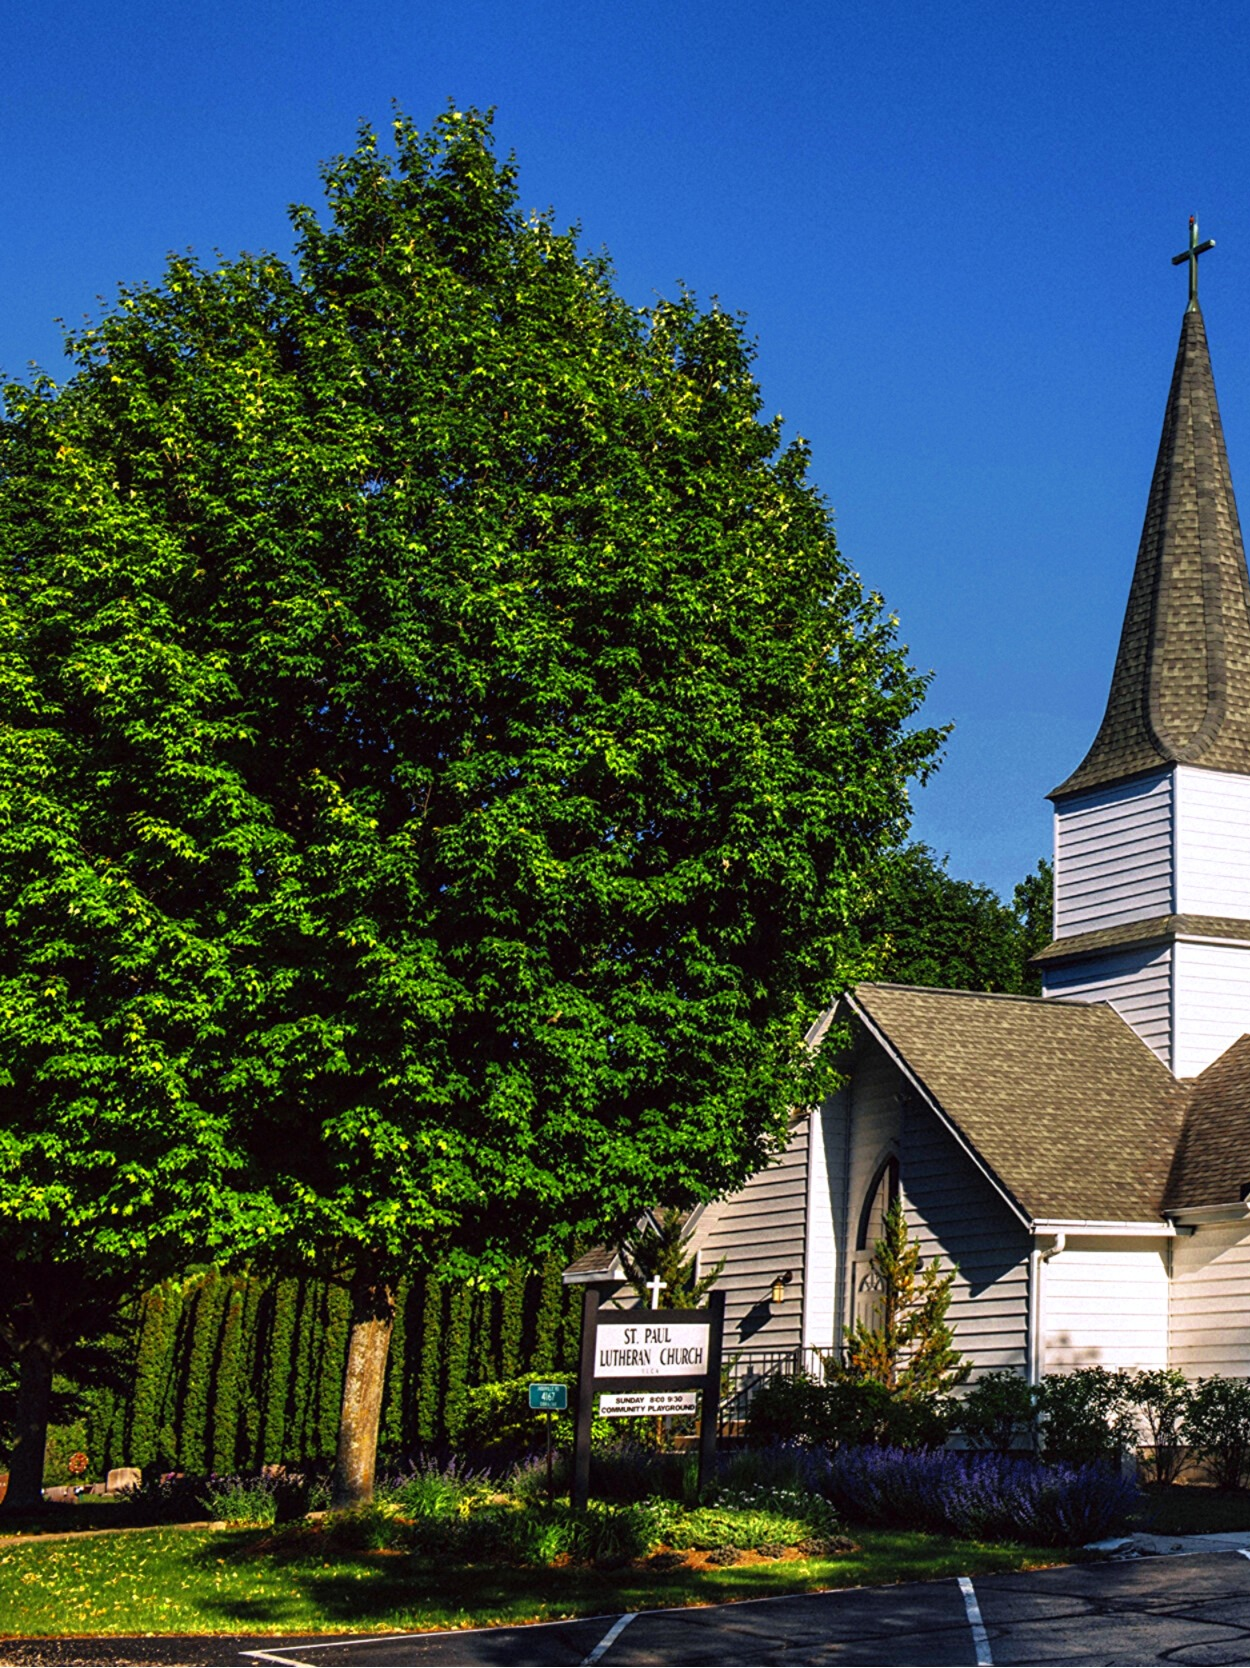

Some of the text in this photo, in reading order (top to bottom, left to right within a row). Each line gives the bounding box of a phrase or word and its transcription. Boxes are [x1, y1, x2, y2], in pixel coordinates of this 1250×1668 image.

[624, 1328, 672, 1345] ST. PAUL
[599, 1347, 703, 1367] LUTHERAN CHURCH
[615, 1396, 645, 1404] SUNDAY
[667, 1395, 683, 1403] 9:30
[601, 1404, 696, 1414] COMMUNITY PLAYGROUND
